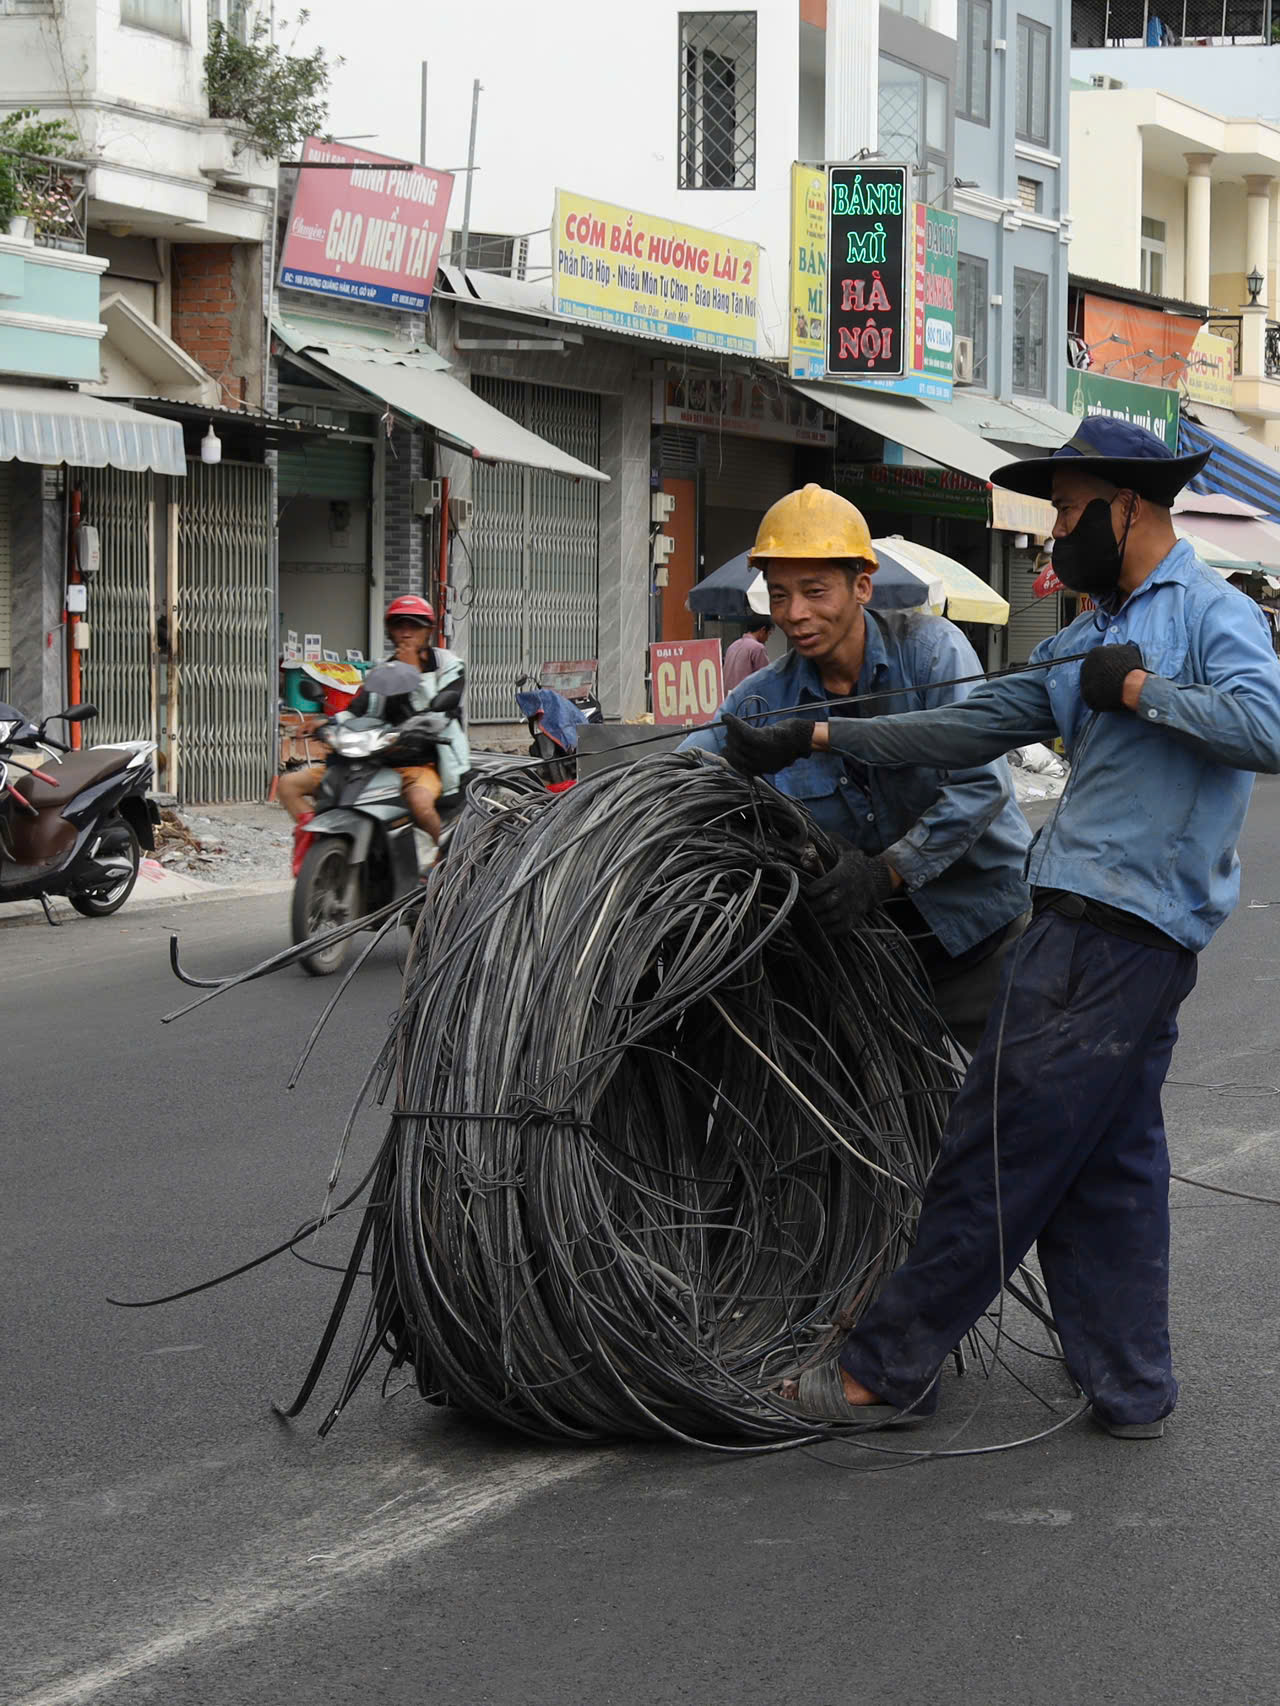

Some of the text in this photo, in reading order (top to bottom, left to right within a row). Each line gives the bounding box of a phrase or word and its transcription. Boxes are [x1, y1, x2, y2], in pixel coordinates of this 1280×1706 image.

[386, 169, 439, 207] PHƯƠNG
[832, 174, 902, 216] BÁNH
[325, 205, 438, 280] GẠO MIỀN TÂY
[565, 211, 606, 249] CƠM
[609, 214, 646, 259] BẮC
[647, 235, 710, 275] HƯƠNG
[741, 259, 753, 285] 2
[798, 243, 825, 275] BÁN
[846, 222, 887, 264] MÌ
[558, 248, 579, 276] Phần
[595, 260, 611, 289] Hộp
[617, 263, 640, 292] Nhiều
[641, 273, 659, 297] Món
[659, 275, 670, 304] Tự
[670, 278, 689, 307] Chọn
[695, 283, 711, 307] Giao
[712, 286, 730, 314] Hàng
[731, 291, 744, 319] Tận
[807, 282, 824, 314] MÌ
[840, 270, 892, 312] HÀ
[838, 317, 893, 368] NỘI
[656, 648, 671, 659] ĐẠI
[657, 658, 718, 725] GẠO
